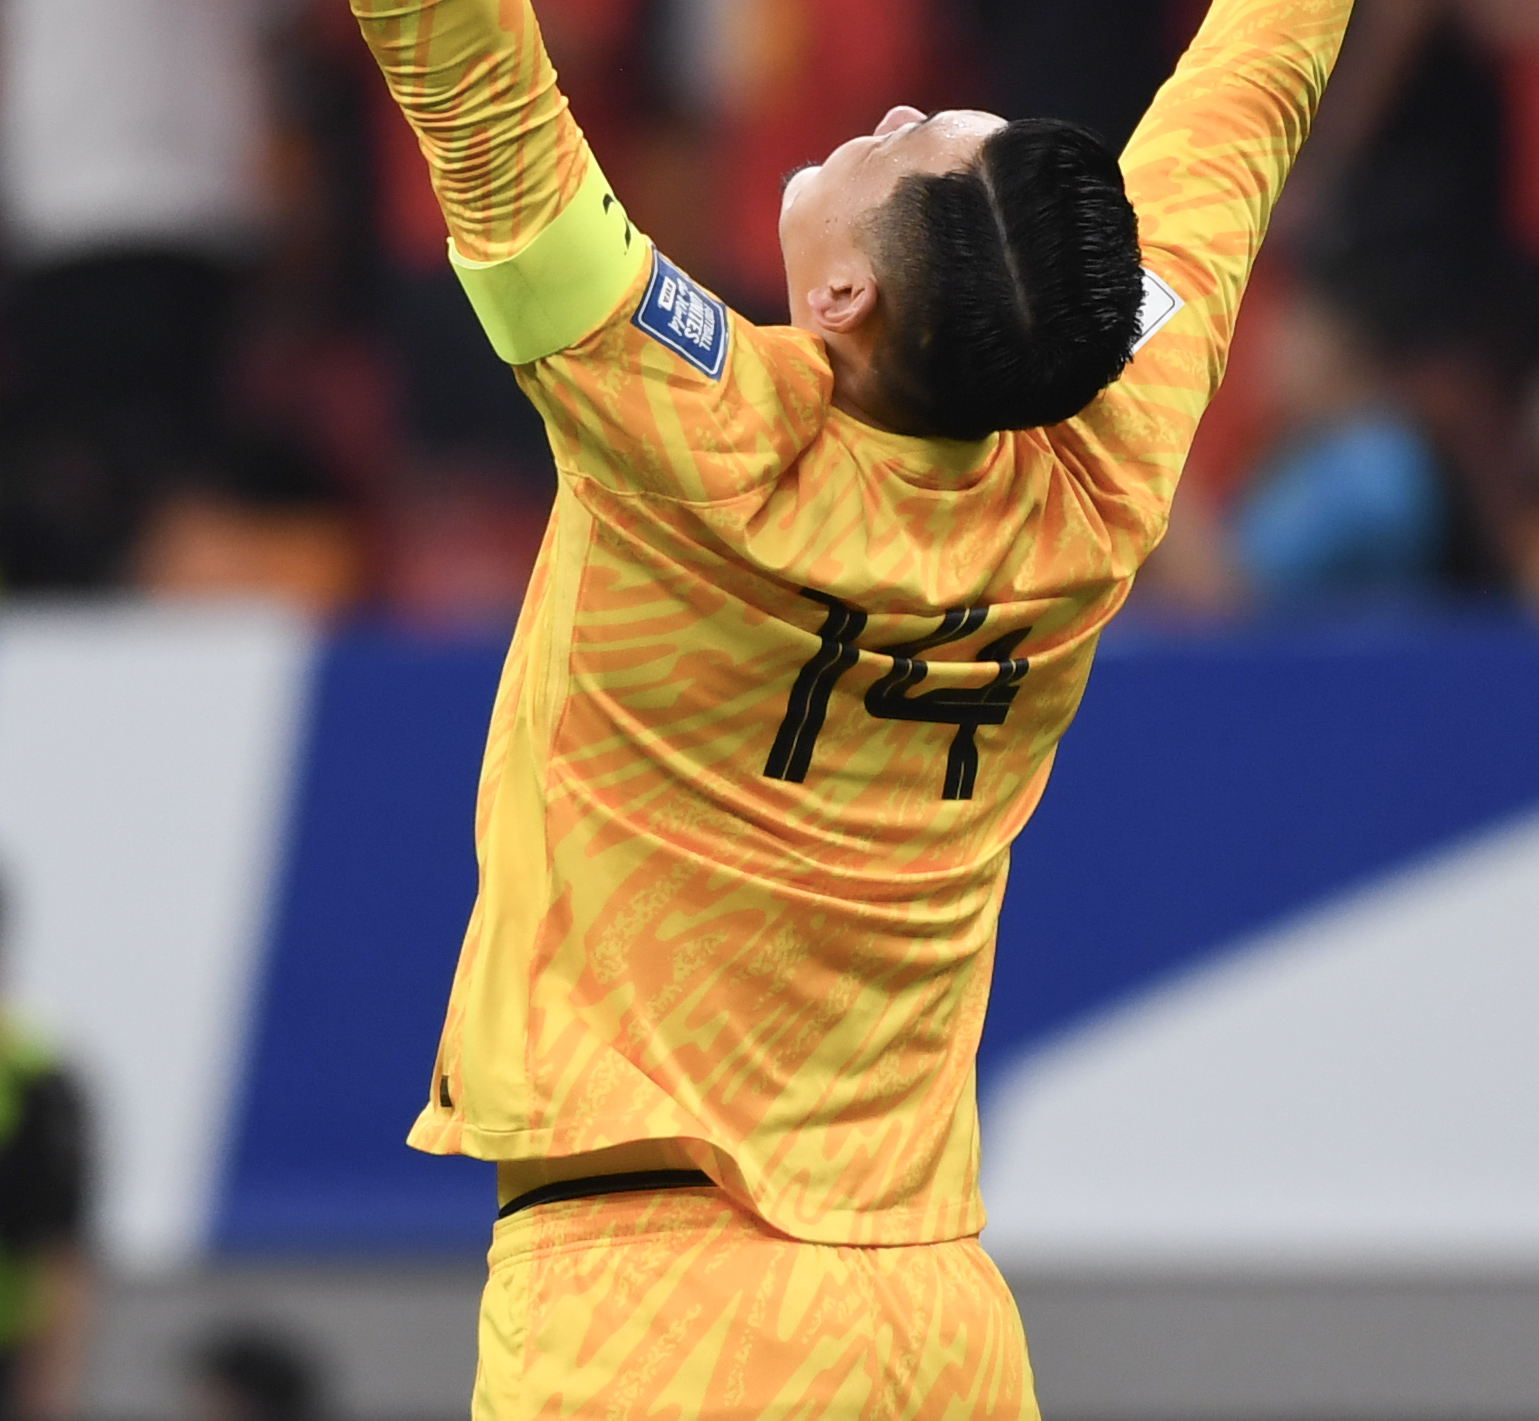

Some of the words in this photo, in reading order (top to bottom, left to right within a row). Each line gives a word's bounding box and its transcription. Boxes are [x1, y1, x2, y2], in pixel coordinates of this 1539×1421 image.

[662, 281, 674, 304] FIFA
[684, 290, 705, 345] UNITES
[762, 587, 1033, 801] 14
